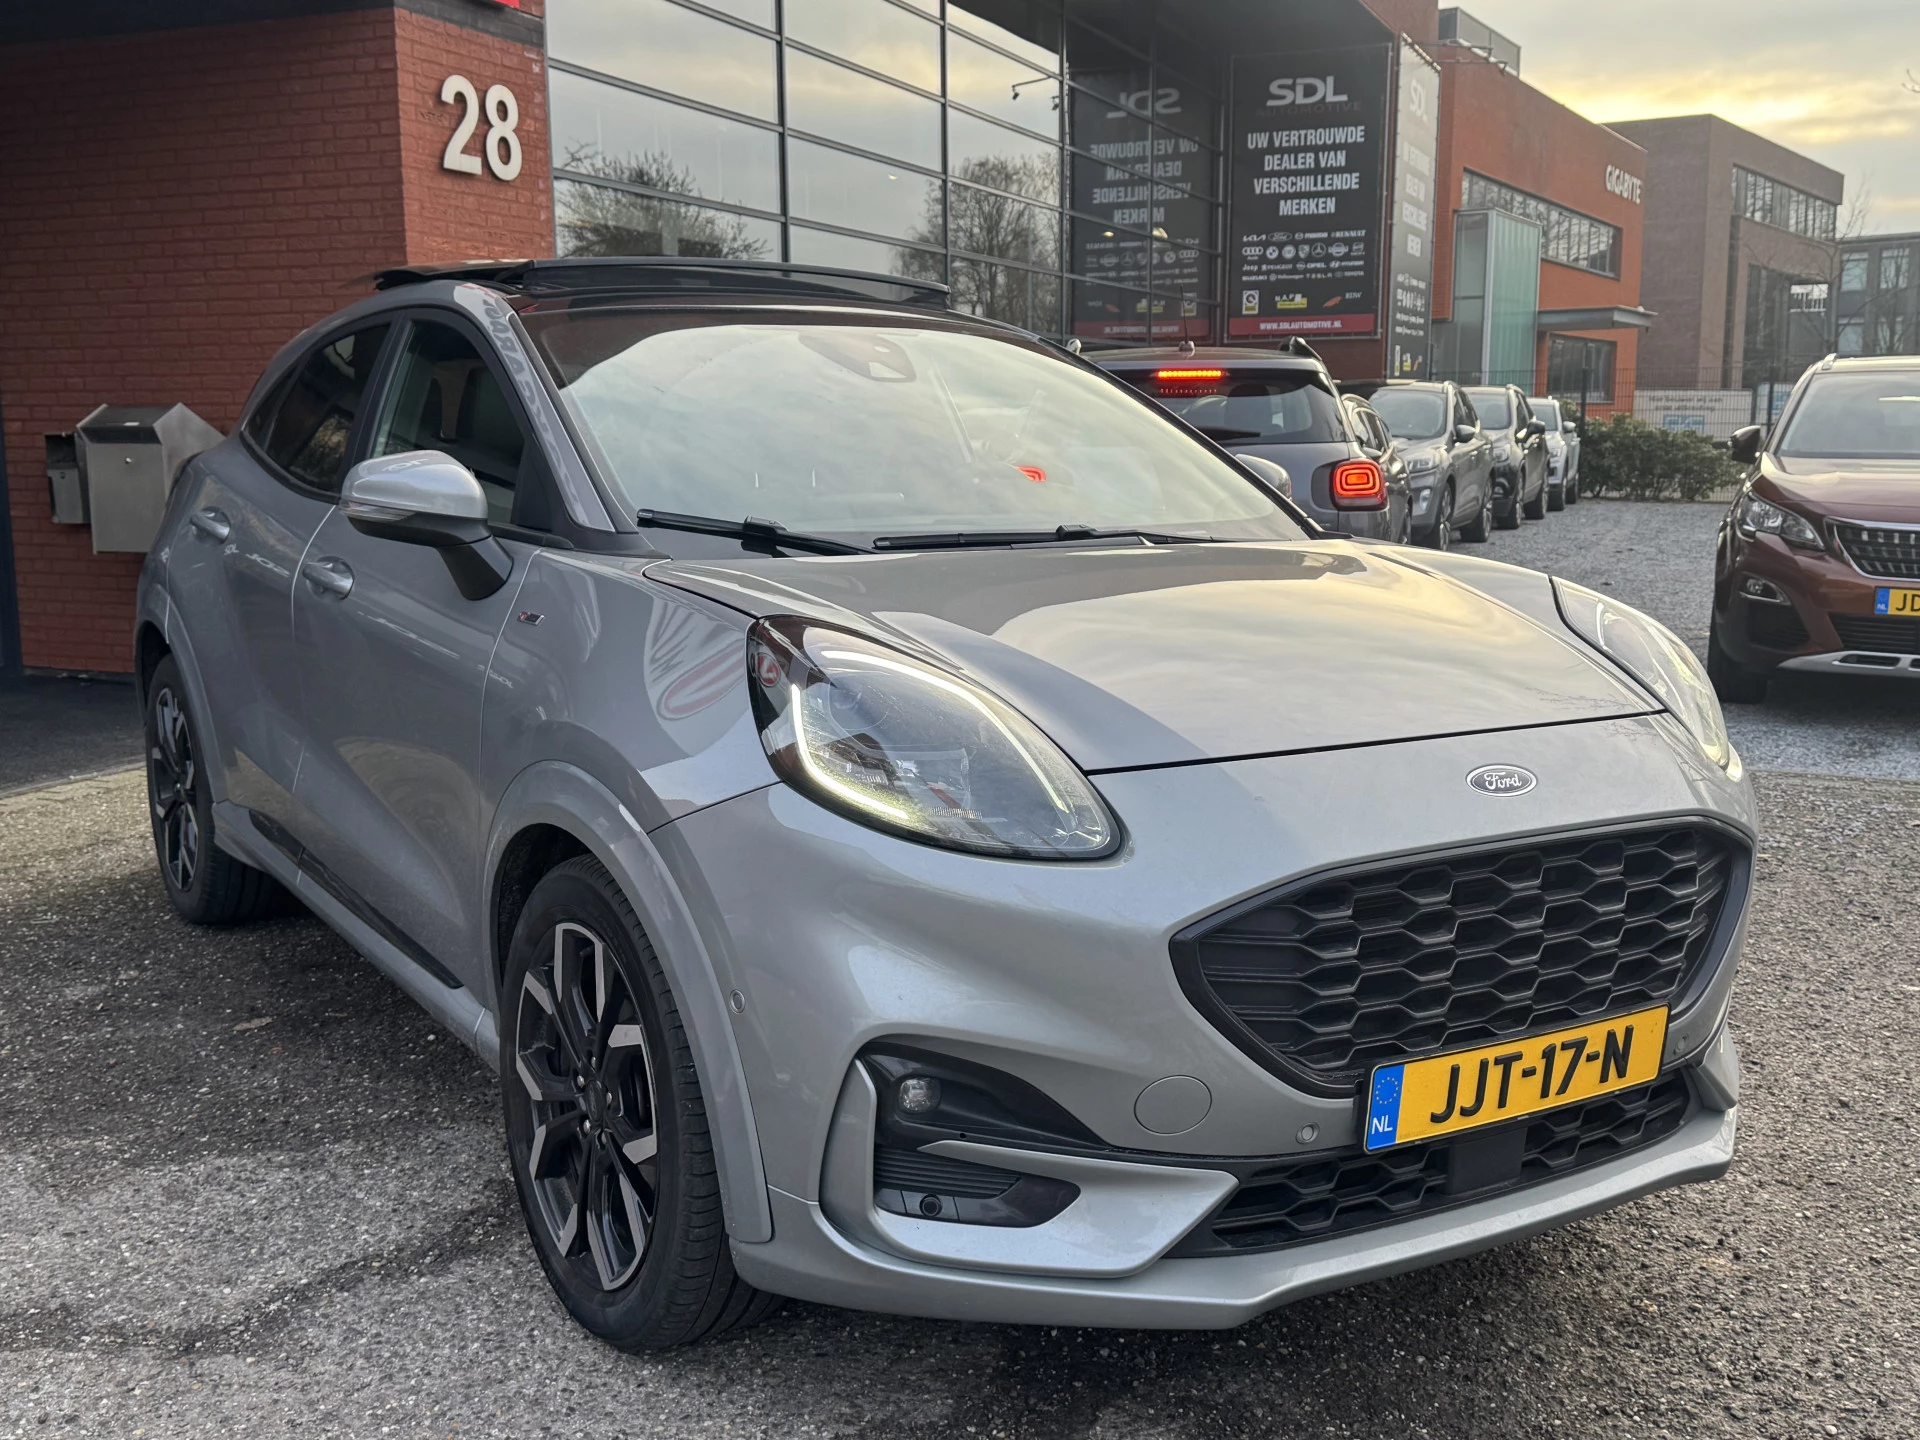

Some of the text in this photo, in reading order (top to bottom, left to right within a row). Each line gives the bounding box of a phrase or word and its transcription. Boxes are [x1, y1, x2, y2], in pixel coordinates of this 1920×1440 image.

[1266, 75, 1348, 106] SDL
[441, 74, 522, 181] 28
[1247, 126, 1365, 149] UW VERTROUWDE
[1264, 150, 1346, 171] DEALER VAN
[1254, 172, 1360, 194] VERSCHILLENDE
[1605, 164, 1643, 205] GIGABYTE
[1279, 197, 1336, 216] MERKEN
[1483, 771, 1522, 790] Ford
[1430, 1024, 1634, 1123] JJT-17-N
[1371, 1114, 1393, 1135] NL
